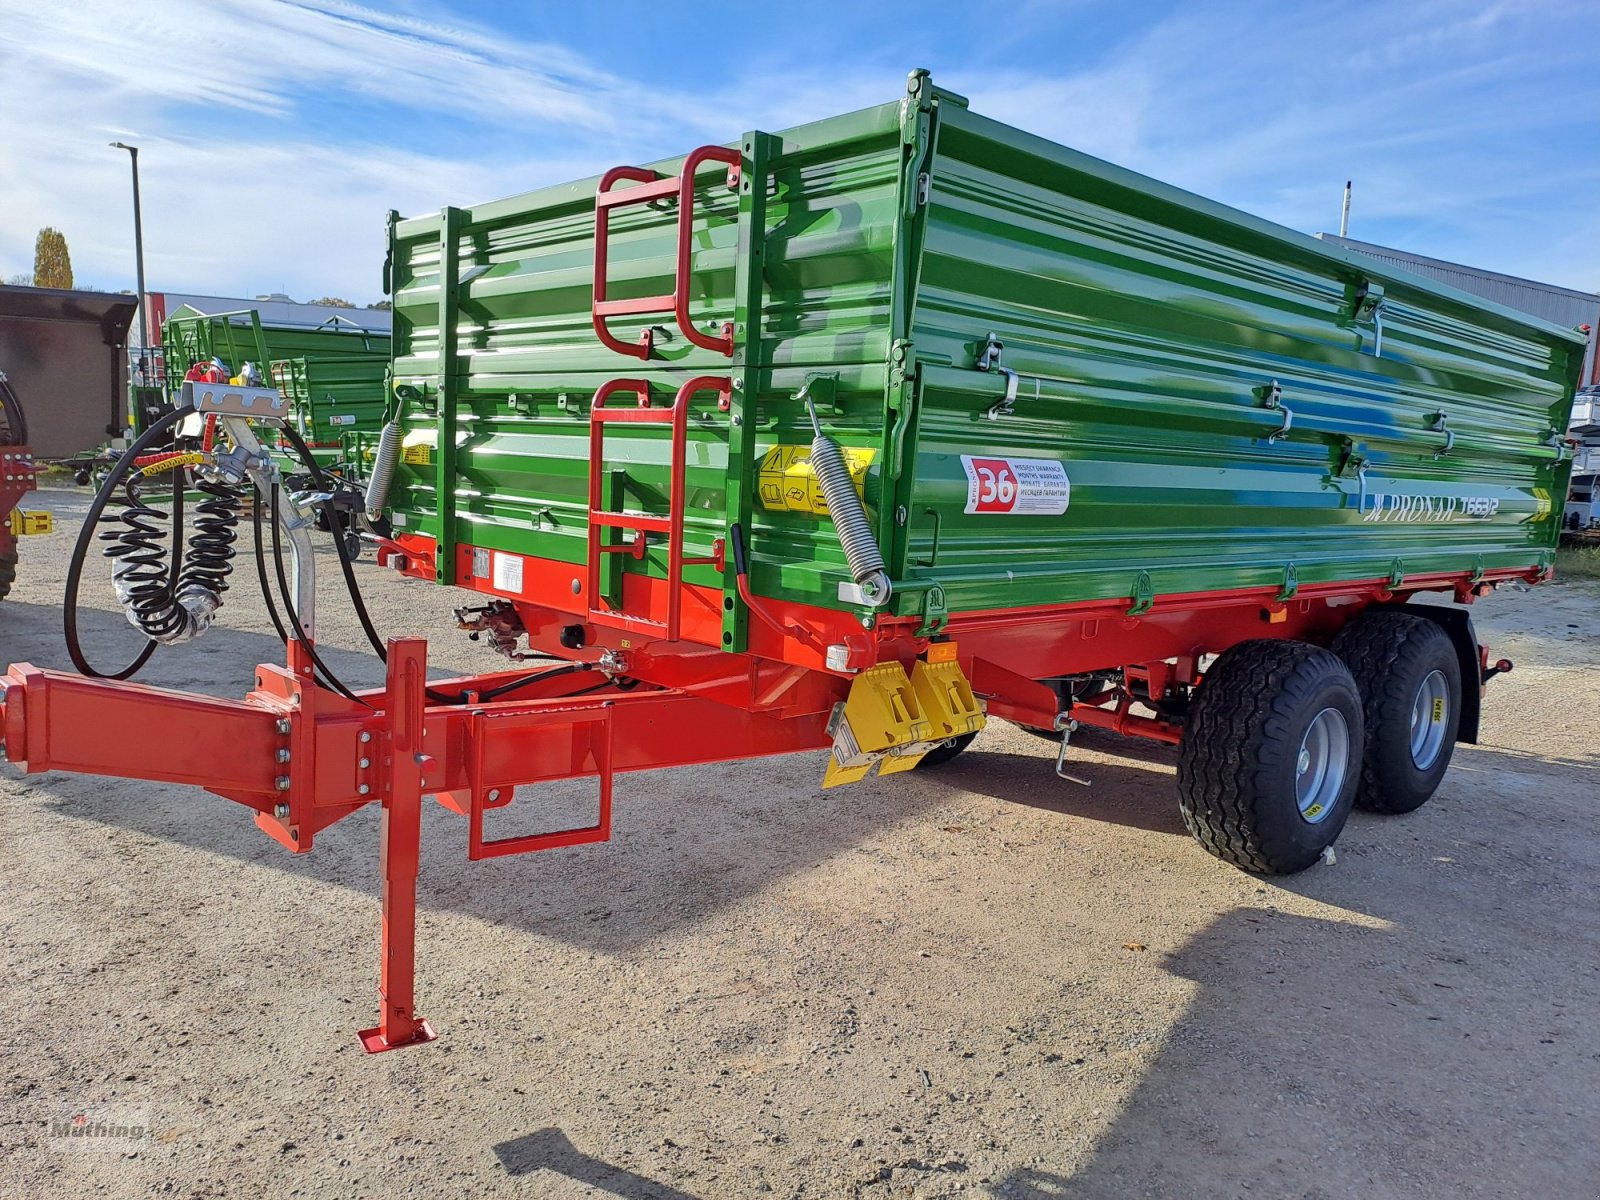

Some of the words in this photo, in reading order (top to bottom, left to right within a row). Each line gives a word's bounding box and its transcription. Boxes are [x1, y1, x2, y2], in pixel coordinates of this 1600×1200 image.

[977, 467, 1014, 504] 36
[1020, 480, 1041, 488] MONATE
[1020, 488, 1042, 497] МЕСЯЦЕВ
[1042, 489, 1067, 497] ГАРАНТИИ
[1382, 495, 1457, 522] PRONAR
[1460, 496, 1499, 518] T663/2
